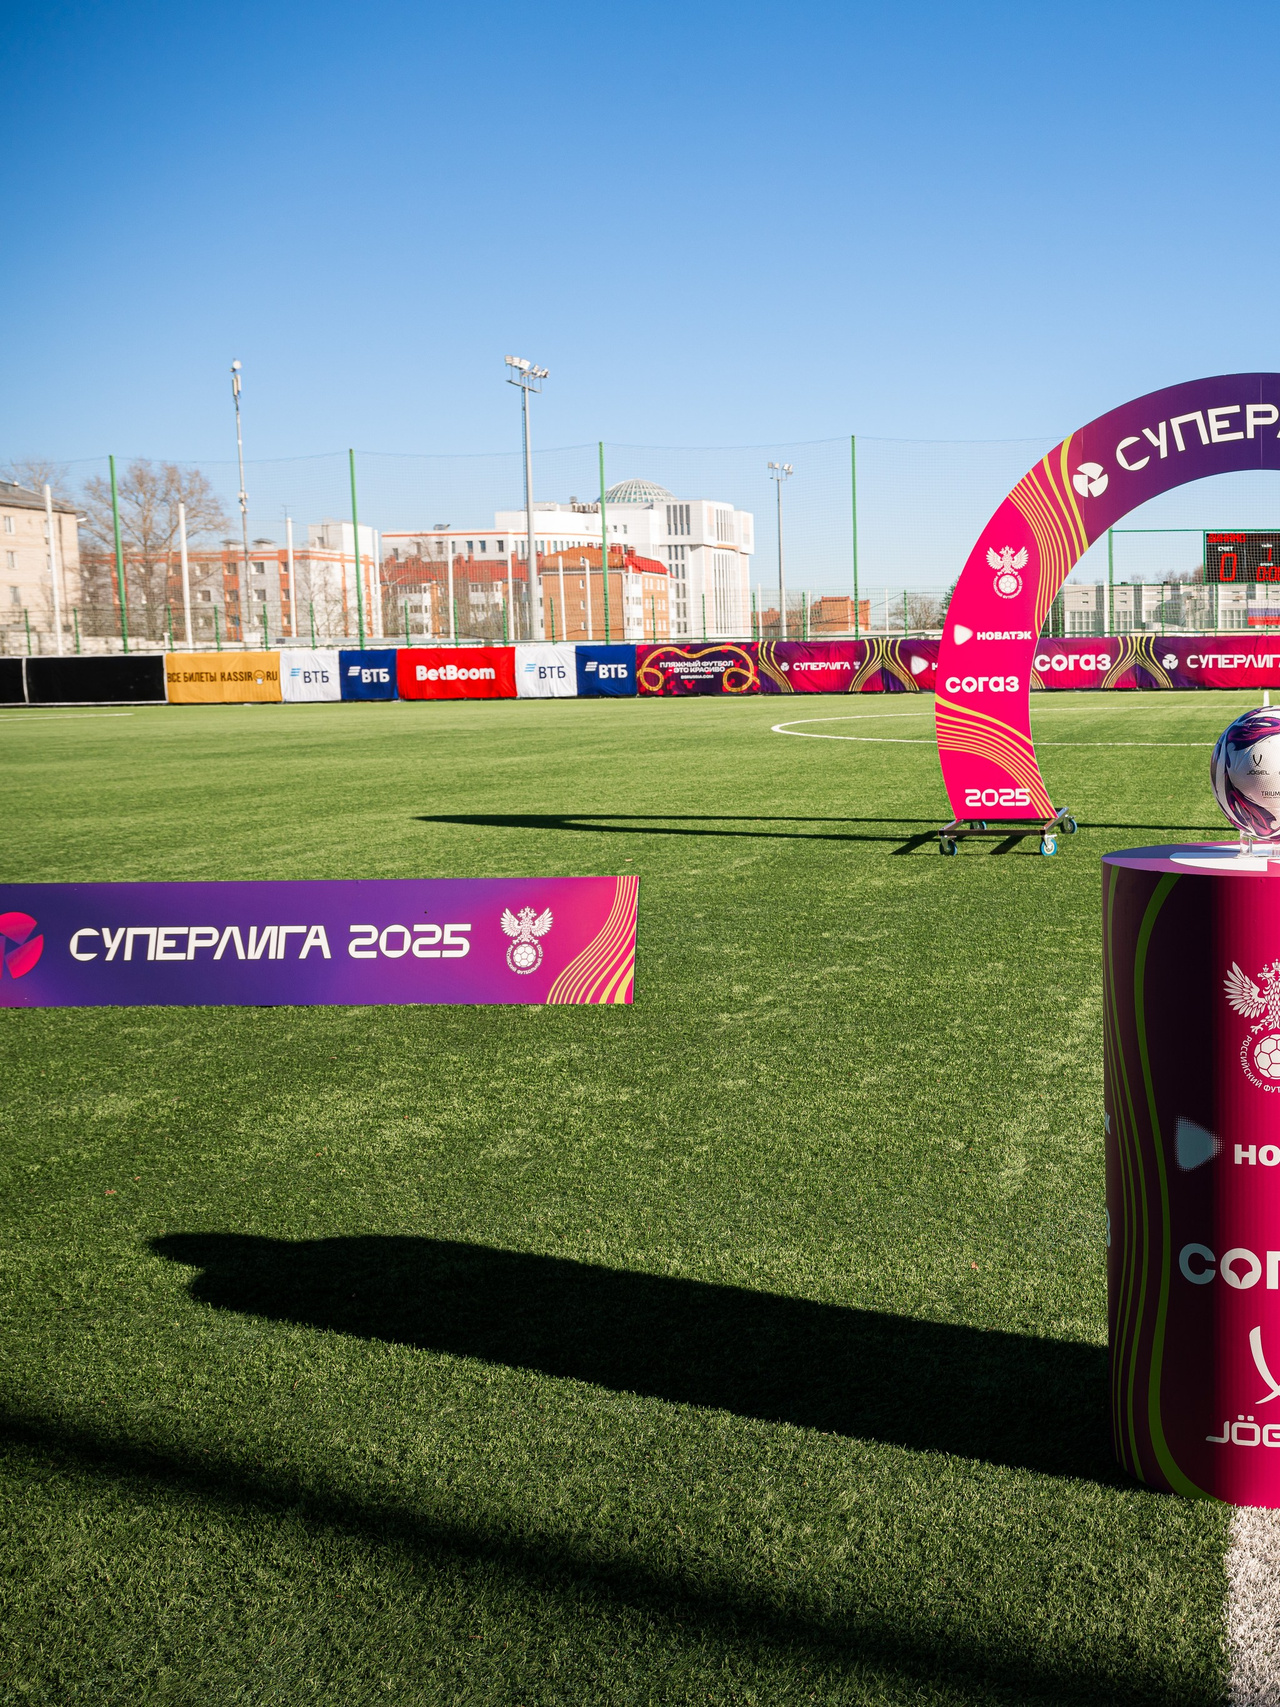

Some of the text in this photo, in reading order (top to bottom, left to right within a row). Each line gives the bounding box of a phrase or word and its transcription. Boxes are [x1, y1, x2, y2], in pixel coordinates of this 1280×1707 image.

[1219, 553, 1237, 581] 0
[976, 631, 1032, 640] НОВАТЭК
[598, 663, 628, 679] ВТБ
[659, 660, 701, 668] ПЛЯЖНЫЙ
[793, 661, 851, 671] СУПЕРЛИГА
[167, 672, 181, 683] ВСЕ
[183, 672, 217, 683] БИЛЕТЫ
[303, 670, 329, 684] ВТБ
[361, 668, 390, 683] ВТБ
[416, 664, 495, 681] BetBoom
[539, 665, 566, 679] ВТБ
[964, 788, 1031, 807] 2025
[69, 924, 472, 961] СУПЕРЛИГА 2025
[1240, 1035, 1263, 1089] РОССИЙСКИЙ
